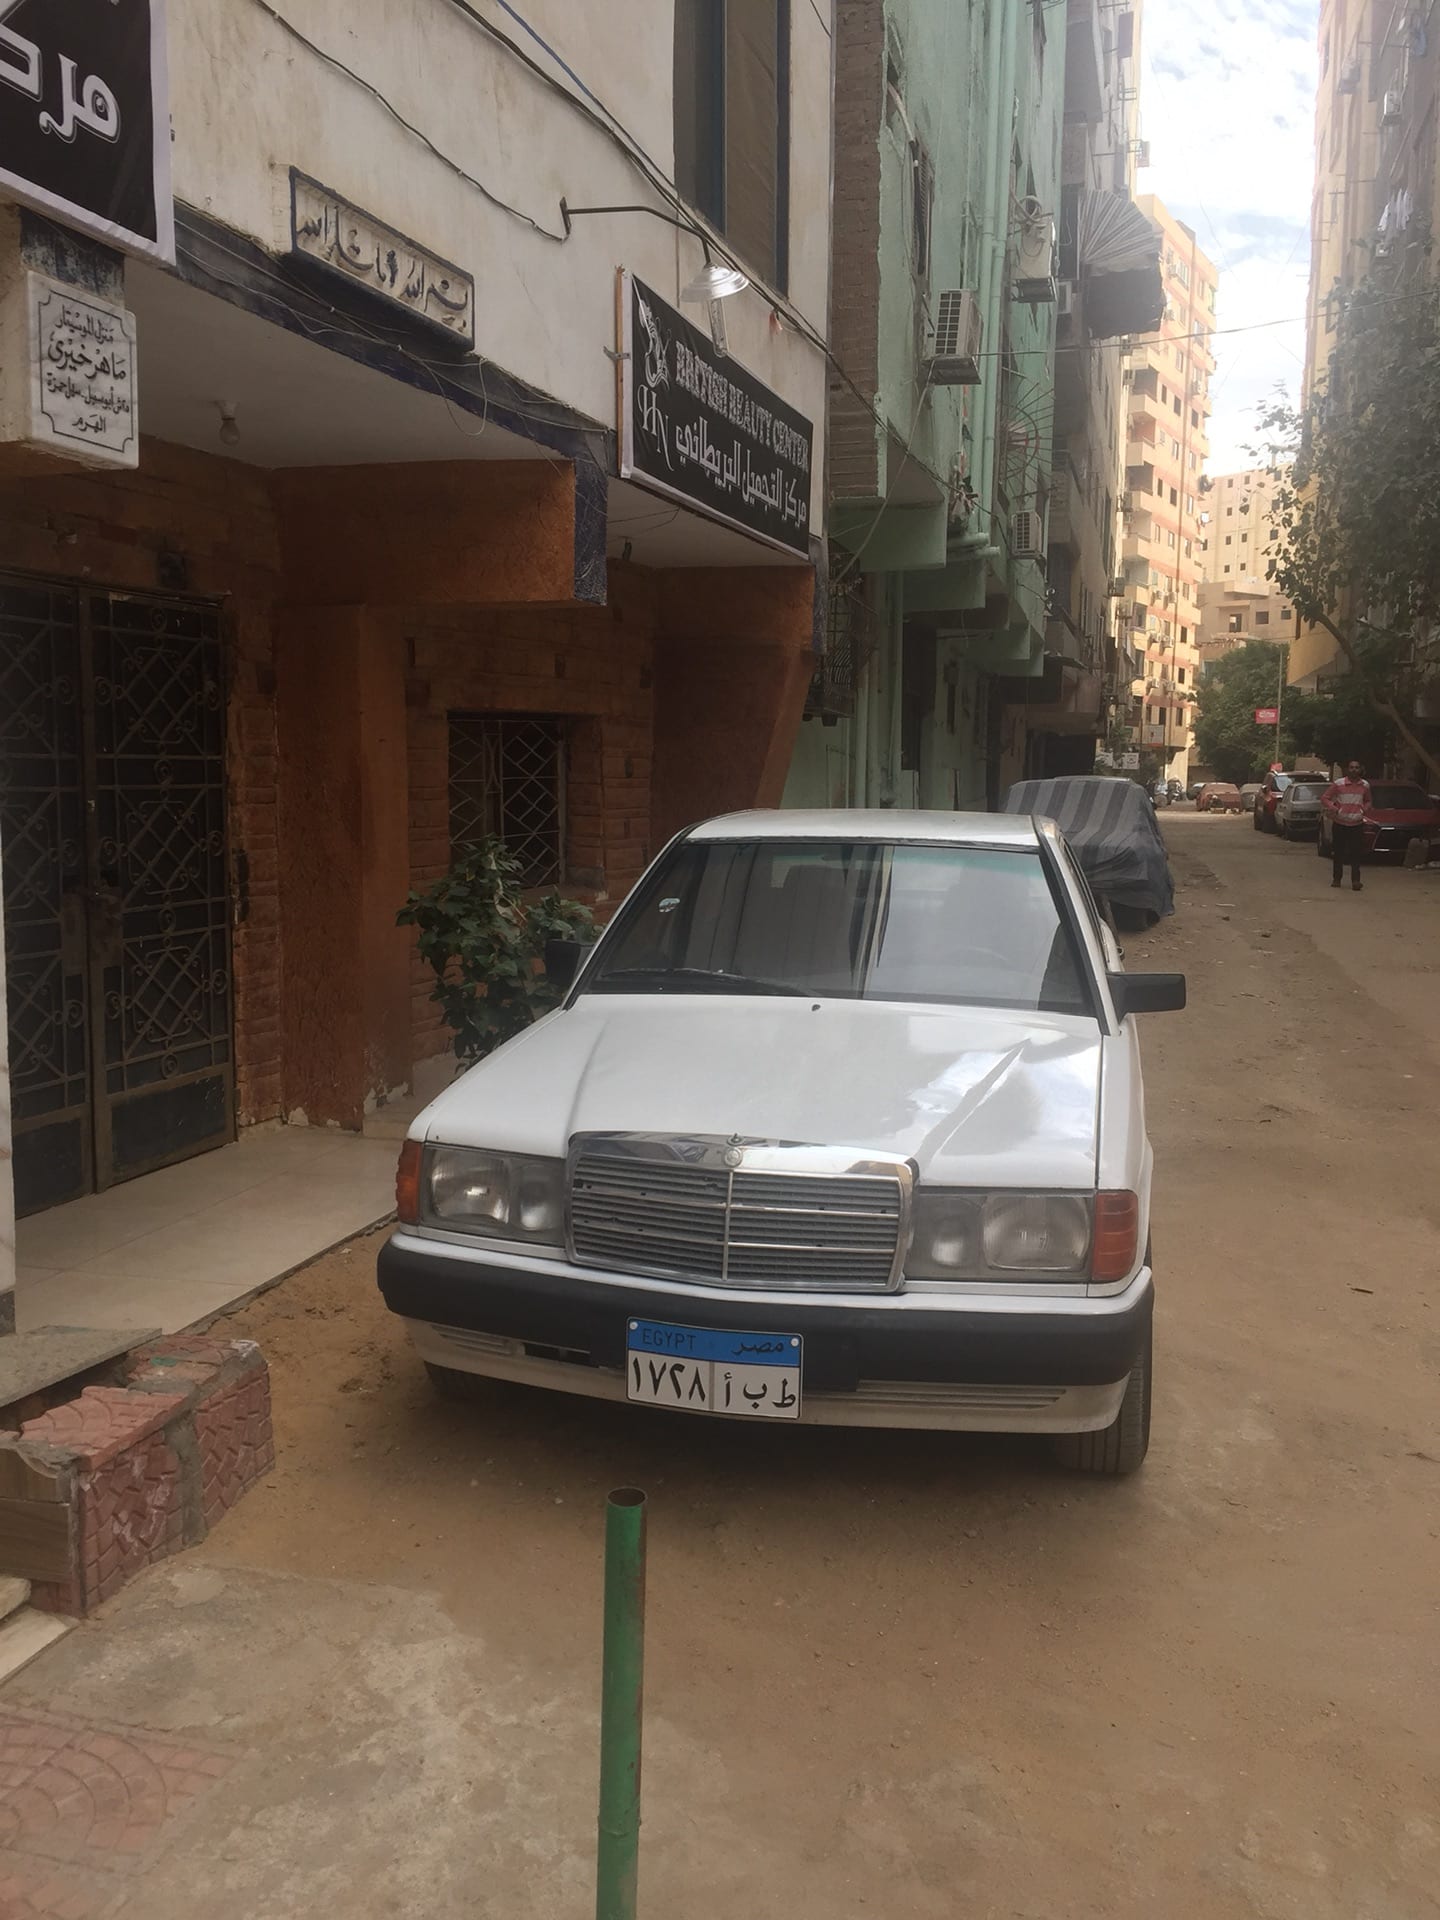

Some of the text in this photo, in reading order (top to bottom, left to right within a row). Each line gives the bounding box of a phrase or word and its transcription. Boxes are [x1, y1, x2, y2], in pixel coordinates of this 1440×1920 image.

[85, 348, 127, 380] ماهر
[72, 414, 107, 434] الهرم
[728, 383, 772, 447] BEAUTY
[772, 418, 809, 474] CENTER
[676, 415, 807, 528] مركز التجميل البريطاني
[642, 1328, 697, 1351] EGYPT
[732, 1340, 785, 1356] مصر
[632, 1356, 706, 1402] ١٧٢٨
